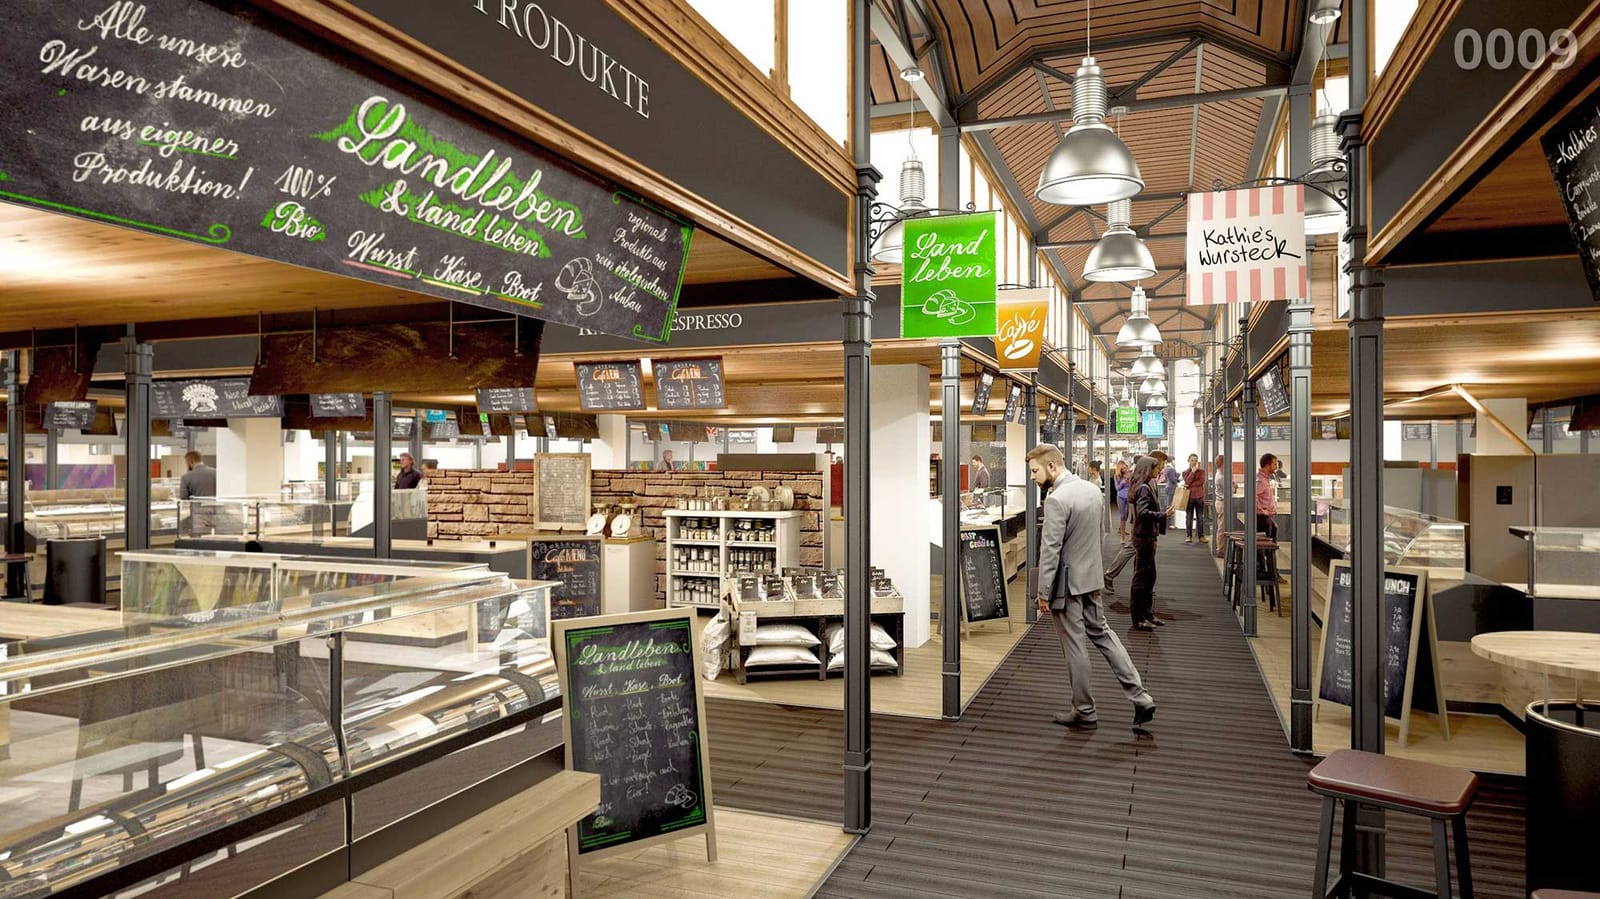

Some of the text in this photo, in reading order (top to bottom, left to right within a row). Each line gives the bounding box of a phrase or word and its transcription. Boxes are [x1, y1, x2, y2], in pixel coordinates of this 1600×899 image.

[78, 1, 247, 68] Alle unsere
[473, 0, 649, 119] RODUKTE
[40, 39, 277, 118] Waren stammen
[80, 113, 239, 159] aus eigener
[73, 151, 254, 200] Produktion!
[338, 96, 585, 236] Landleben
[274, 164, 337, 200] 100%
[270, 201, 321, 238] Bio
[381, 180, 539, 257] & land leben
[911, 229, 988, 259] Land
[1203, 226, 1273, 247] Kathie's
[595, 252, 614, 271] rein
[652, 257, 667, 272] aus
[909, 256, 991, 283] leben
[501, 270, 544, 301] Brot
[609, 286, 642, 313] Anbau
[1385, 578, 1410, 593] UNCH
[579, 638, 675, 667] Landleben
[636, 657, 661, 670] leben
[659, 673, 682, 686] Brot
